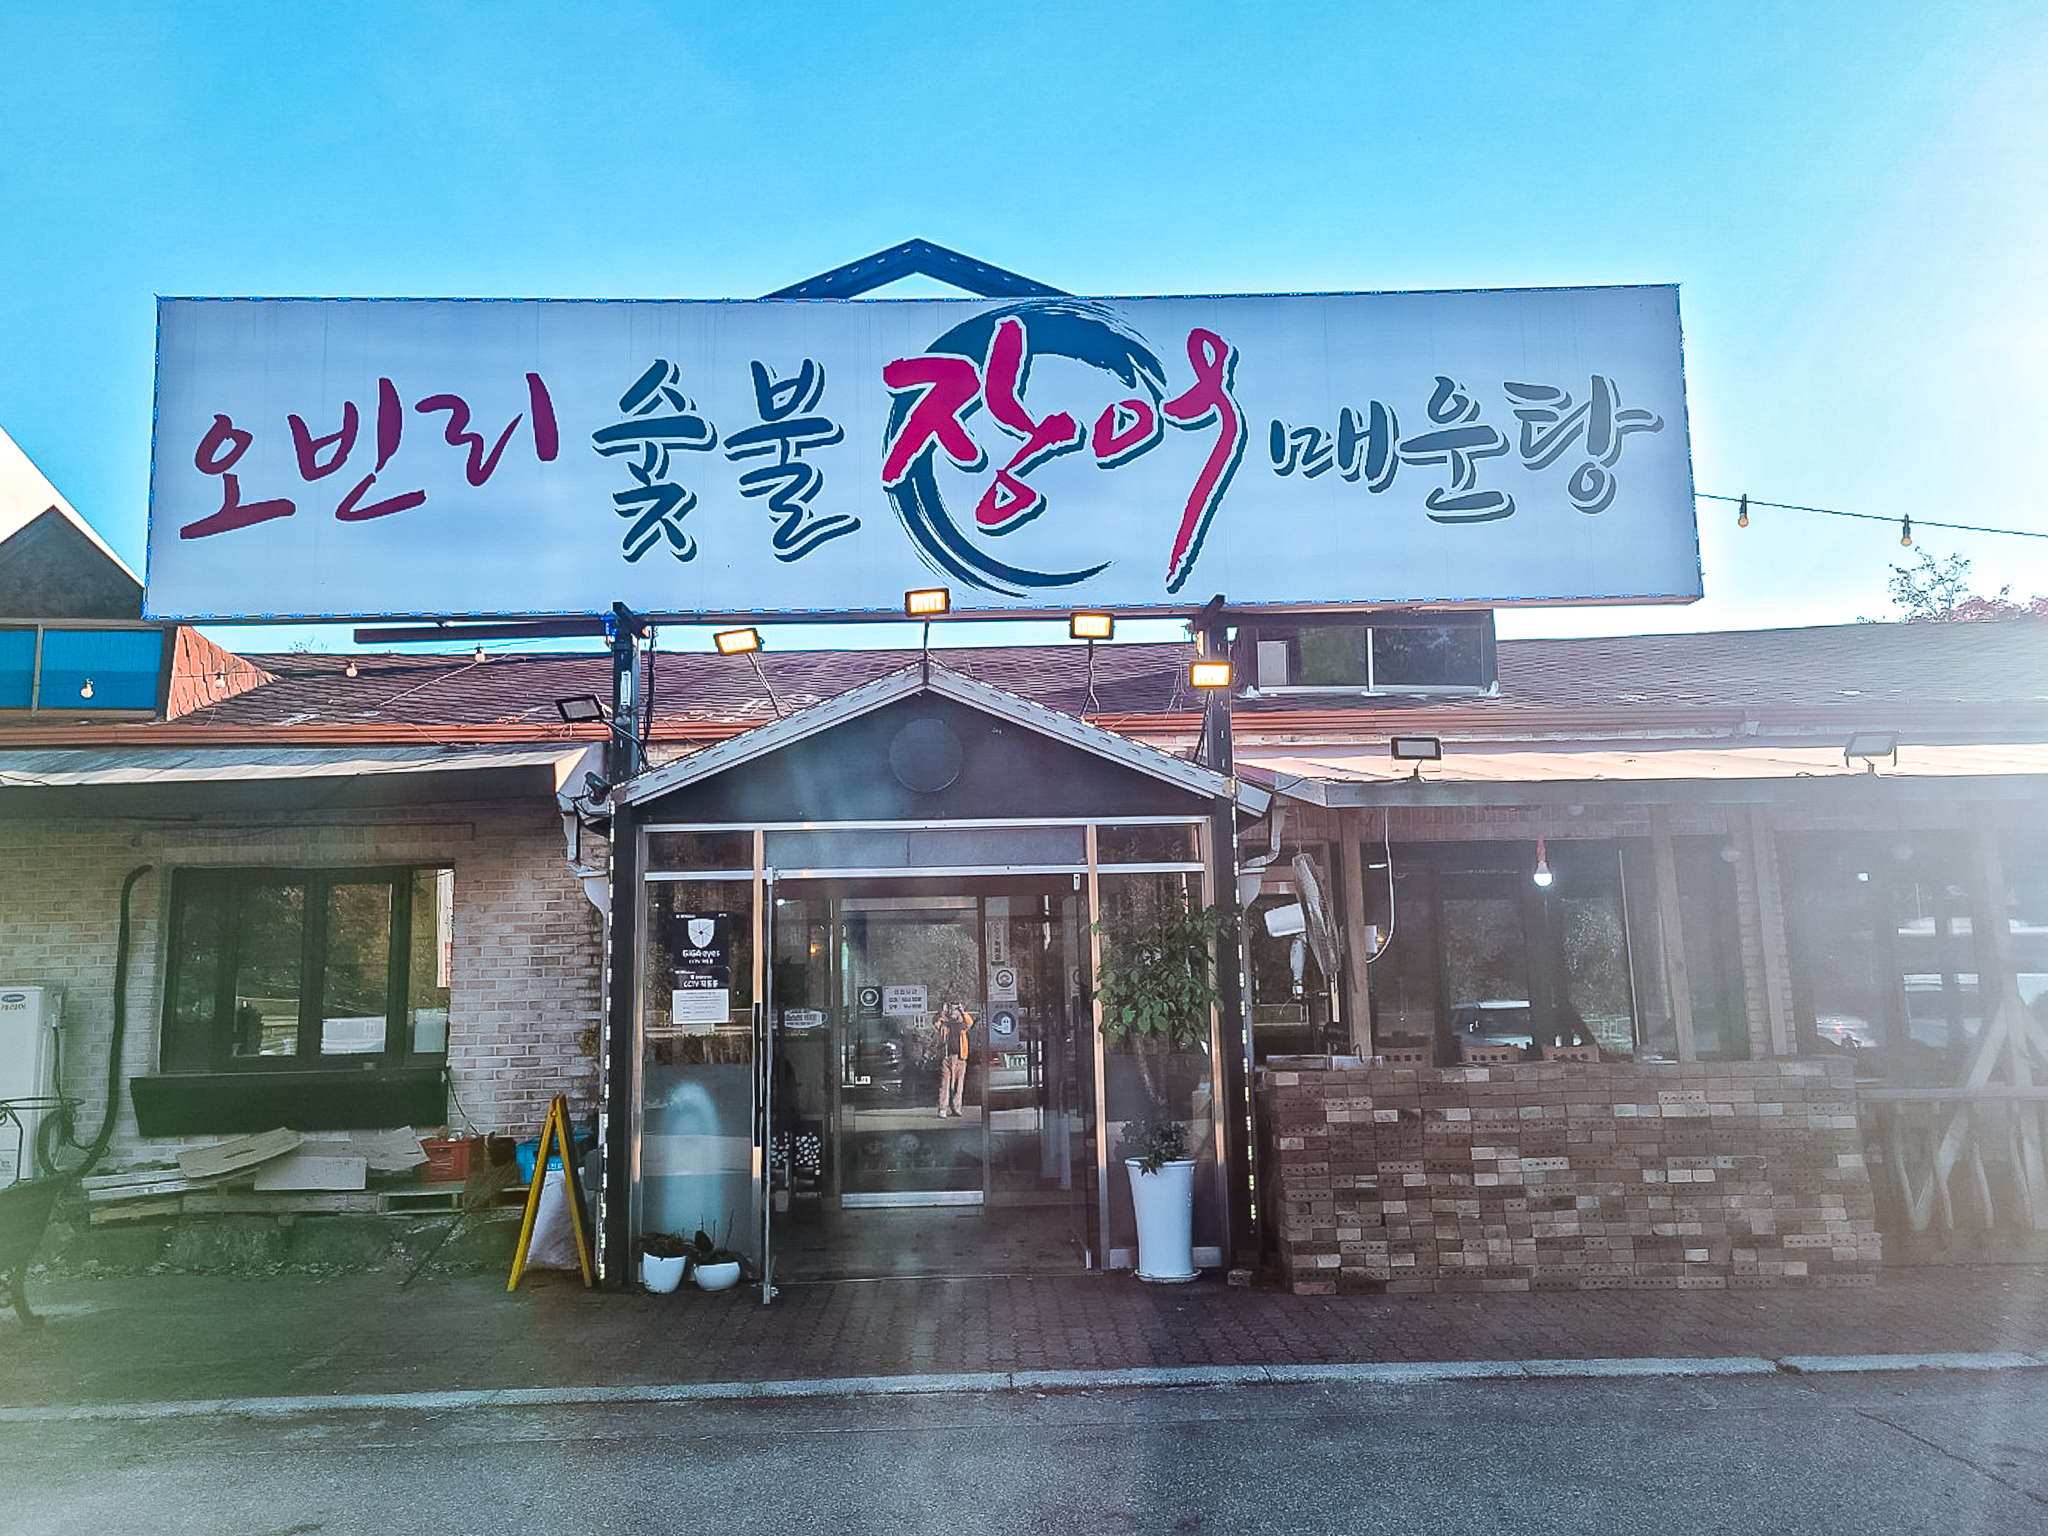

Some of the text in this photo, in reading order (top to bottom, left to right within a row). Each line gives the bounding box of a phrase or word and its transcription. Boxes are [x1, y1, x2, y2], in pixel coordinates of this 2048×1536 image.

[180, 316, 1665, 594] 오빈리 숯불 장어 매운탕
